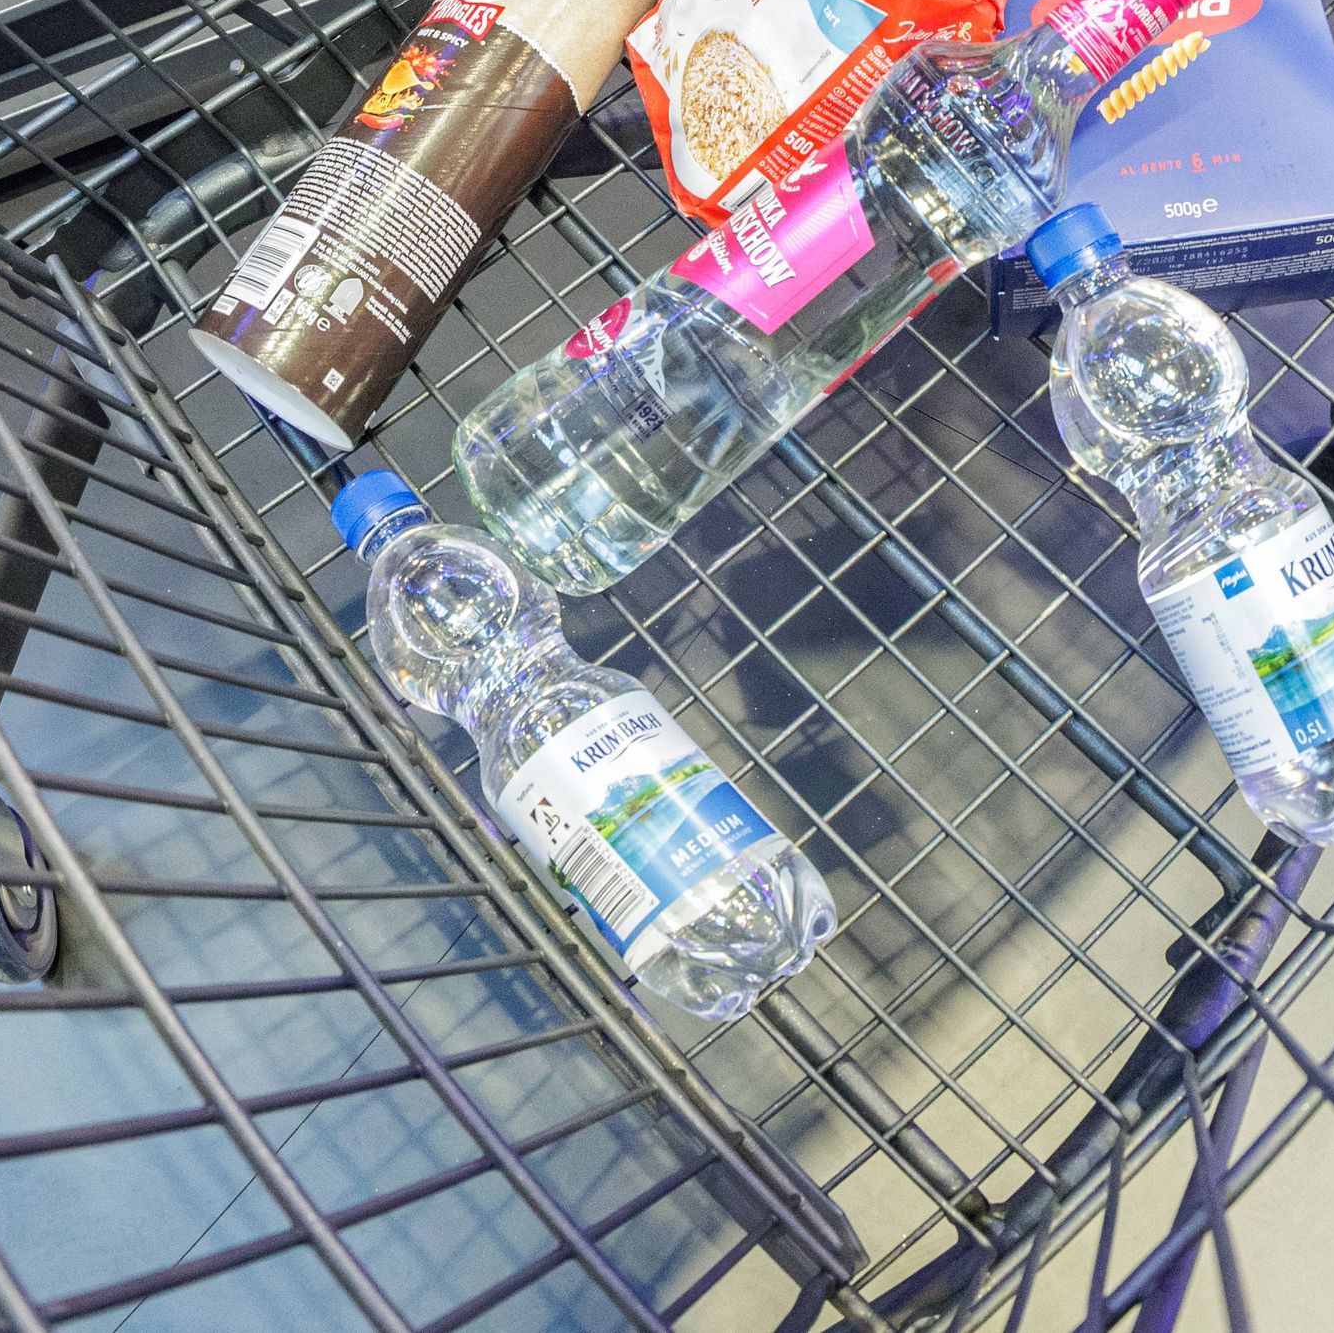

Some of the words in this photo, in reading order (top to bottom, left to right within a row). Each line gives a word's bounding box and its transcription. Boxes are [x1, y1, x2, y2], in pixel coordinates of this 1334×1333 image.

[822, 1, 842, 28] zart
[419, 27, 434, 40] HOT
[440, 31, 471, 48] SPICY
[1191, 153, 1204, 169] 6
[1211, 152, 1242, 166] MIN
[320, 232, 382, 276] www.pringles.com
[569, 712, 664, 775] KRUMBACH
[668, 812, 745, 869] MEDIUM
